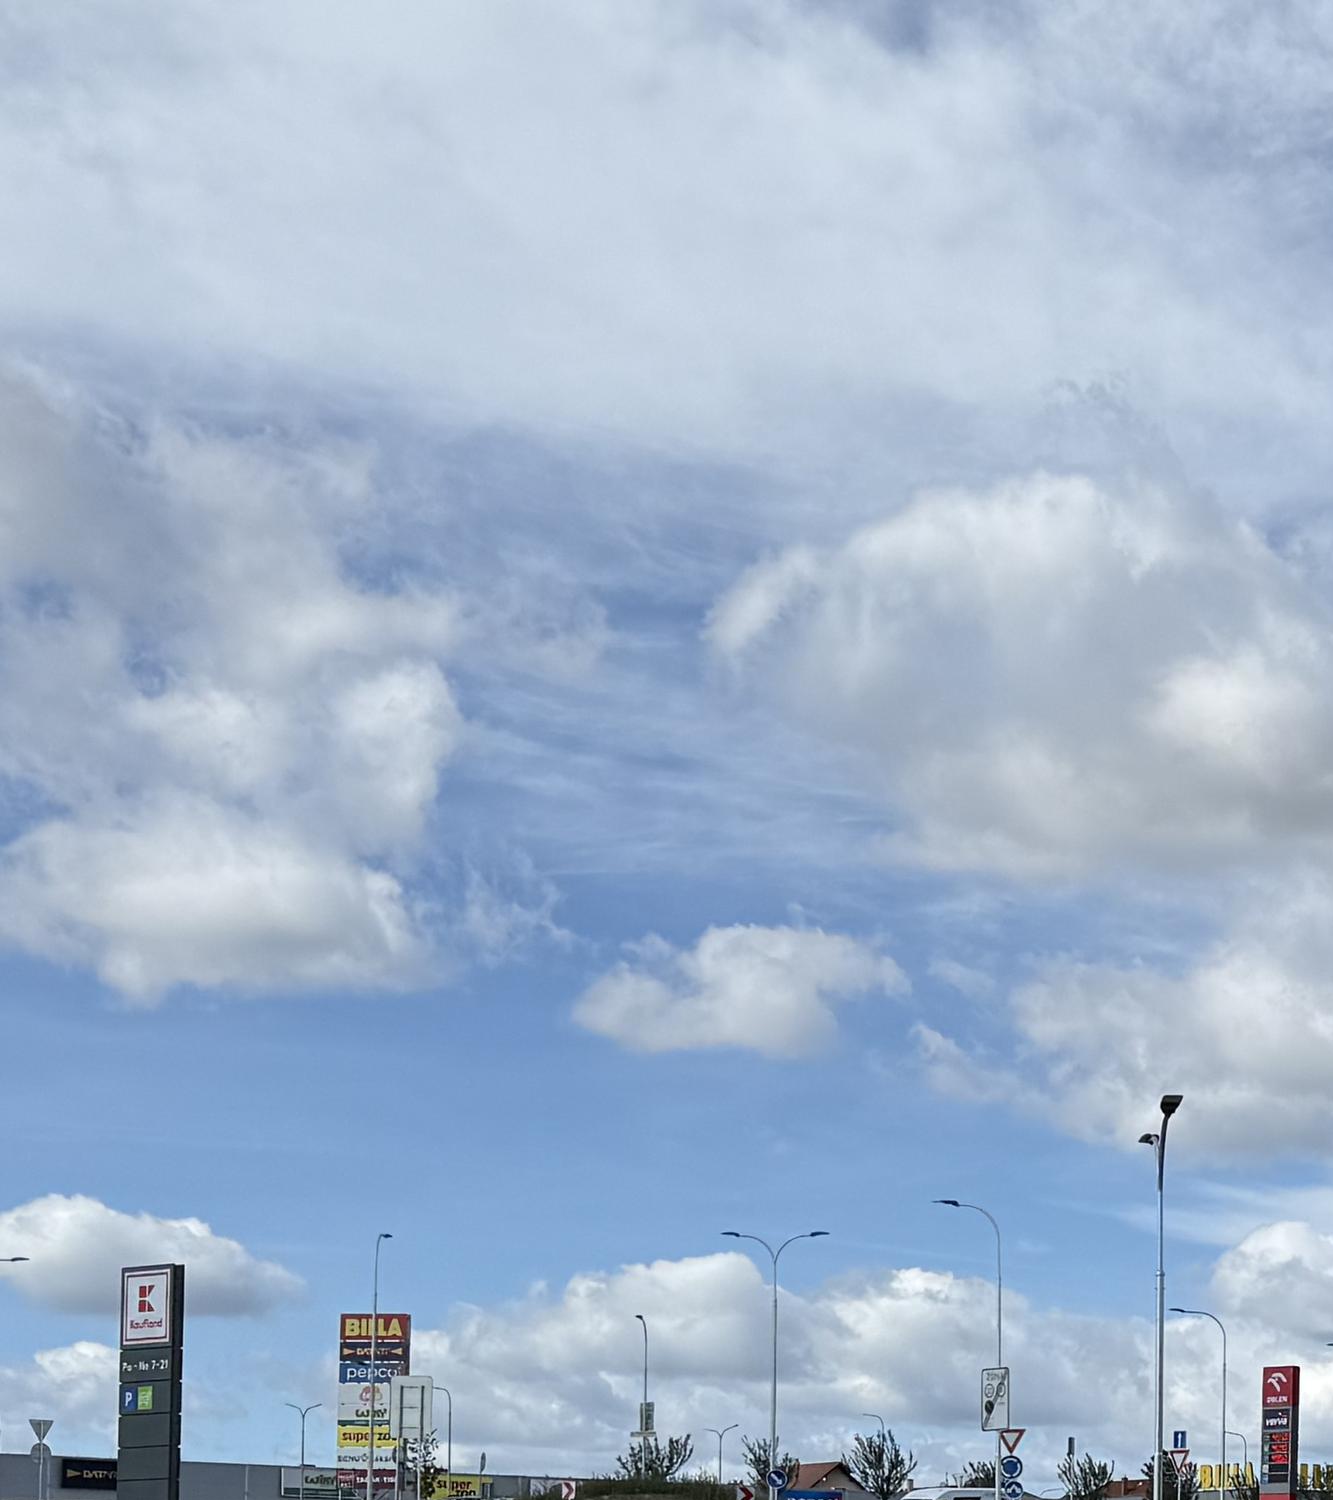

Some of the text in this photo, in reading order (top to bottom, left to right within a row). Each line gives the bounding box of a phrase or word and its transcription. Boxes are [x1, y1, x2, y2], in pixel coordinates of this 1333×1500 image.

[130, 1318, 163, 1329] Kaufland
[345, 1318, 402, 1337] BILLA
[342, 1431, 373, 1443] supe
